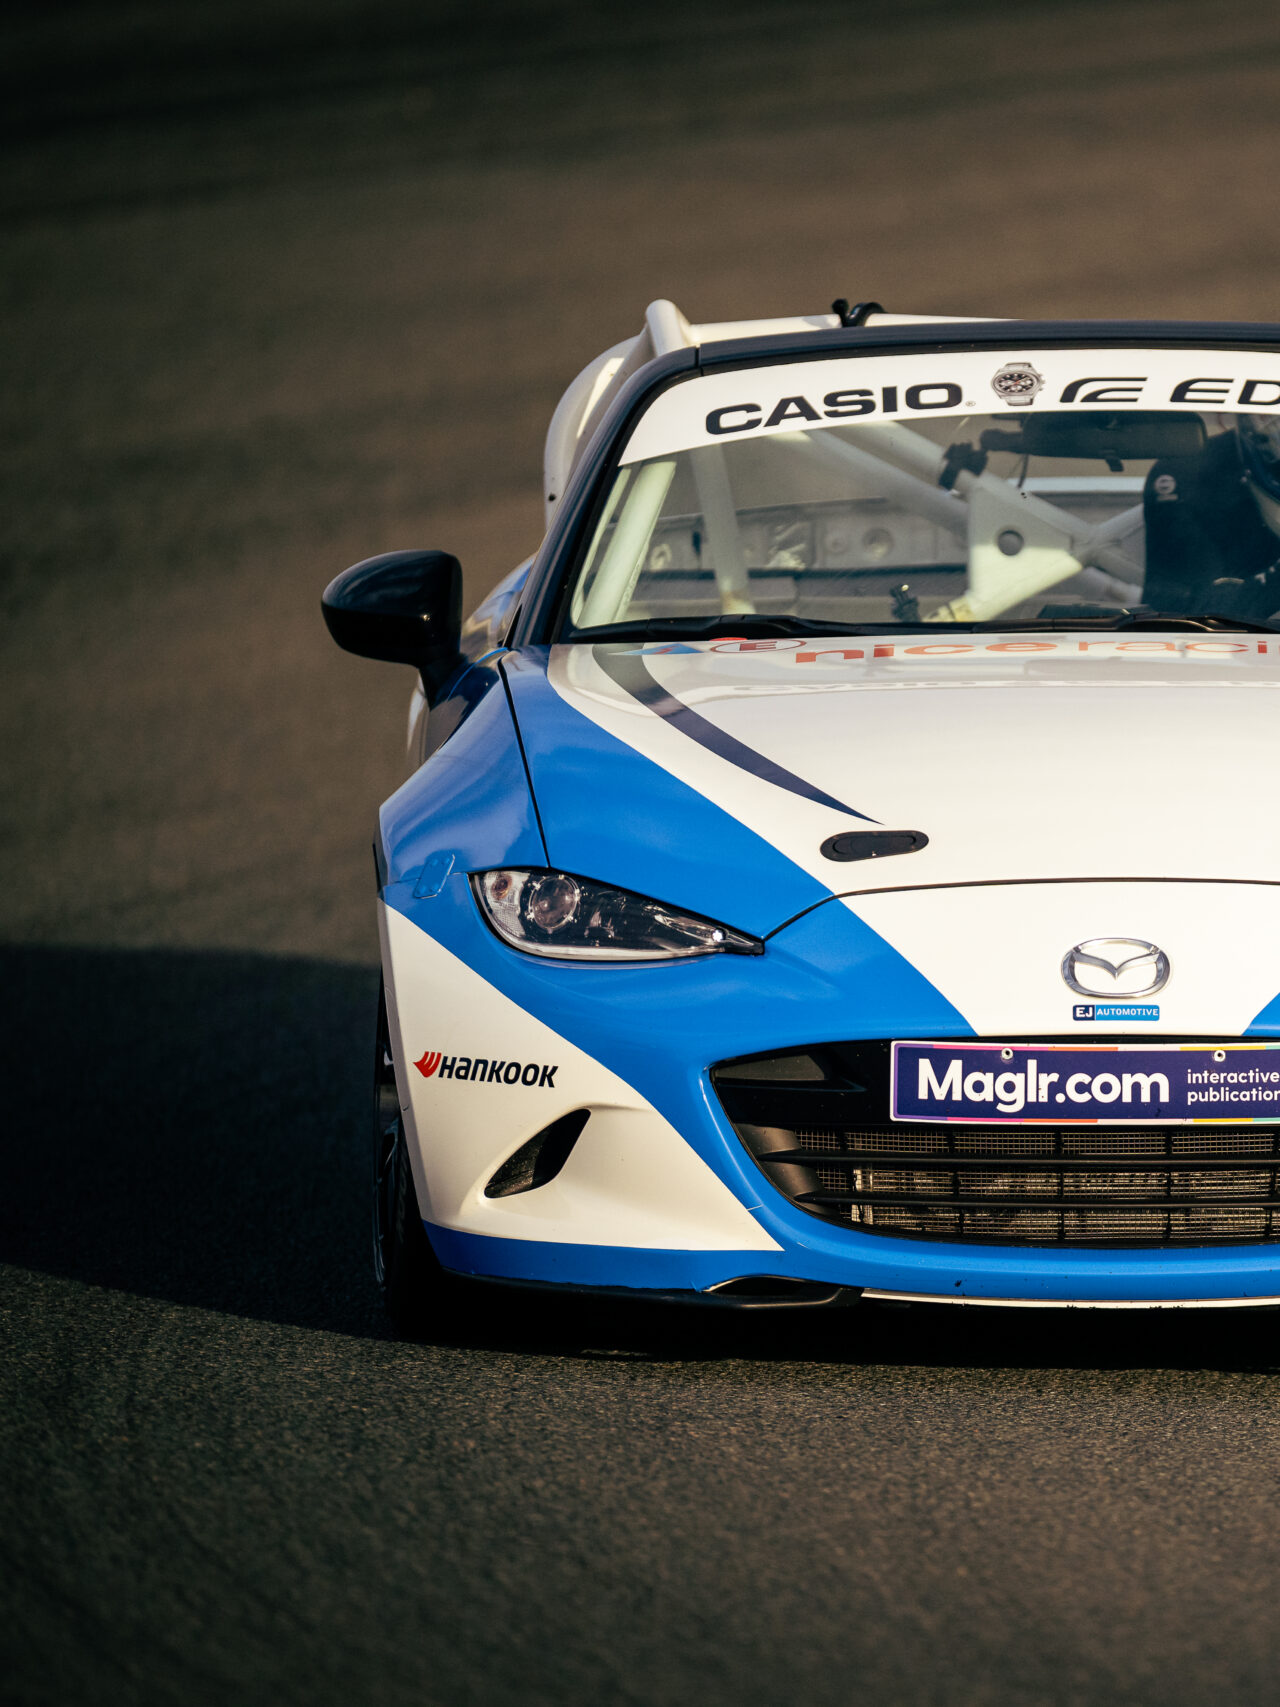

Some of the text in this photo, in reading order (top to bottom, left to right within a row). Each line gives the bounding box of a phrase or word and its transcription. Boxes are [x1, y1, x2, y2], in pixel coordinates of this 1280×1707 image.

[705, 382, 963, 435] CASIO
[796, 642, 1057, 663] nice
[1075, 1007, 1159, 1018] EJ AUTOMOTIVE
[917, 1058, 1169, 1113] Maglr.com
[1187, 1068, 1280, 1085] interactive
